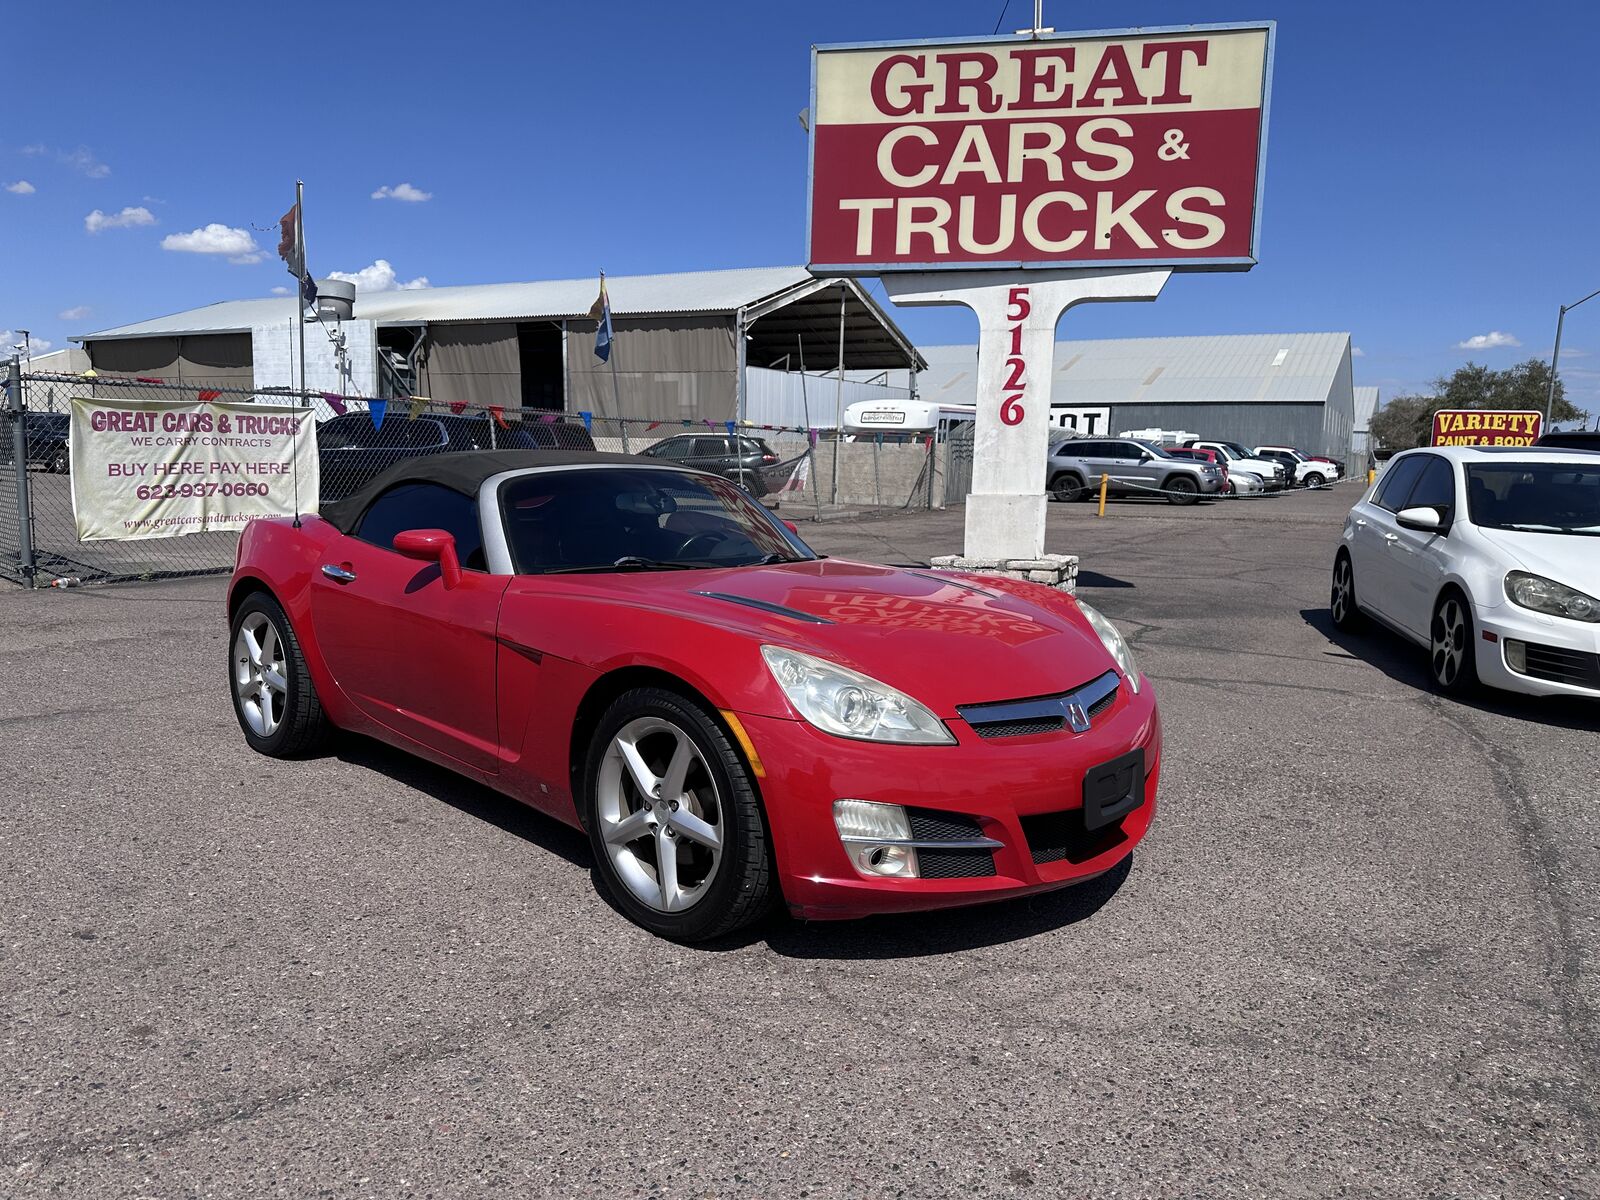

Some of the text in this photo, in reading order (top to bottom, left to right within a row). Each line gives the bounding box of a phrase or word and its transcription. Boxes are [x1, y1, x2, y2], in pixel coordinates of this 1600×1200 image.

[870, 40, 1209, 117] GREAT
[876, 117, 1191, 188] CARS &
[838, 186, 1226, 256] TRUCKS
[91, 411, 301, 436] GREAT CARS & TRUCKS
[1438, 413, 1538, 435] VARIETY
[131, 437, 271, 448] WE CARRY CONTRACTS
[1436, 435, 1534, 447] PAINT & BODY
[108, 462, 291, 477] BUY HERE PAY HERE
[136, 482, 269, 500] 623-937-0660
[124, 511, 281, 529] www.greatcarsandtrucksazcom
